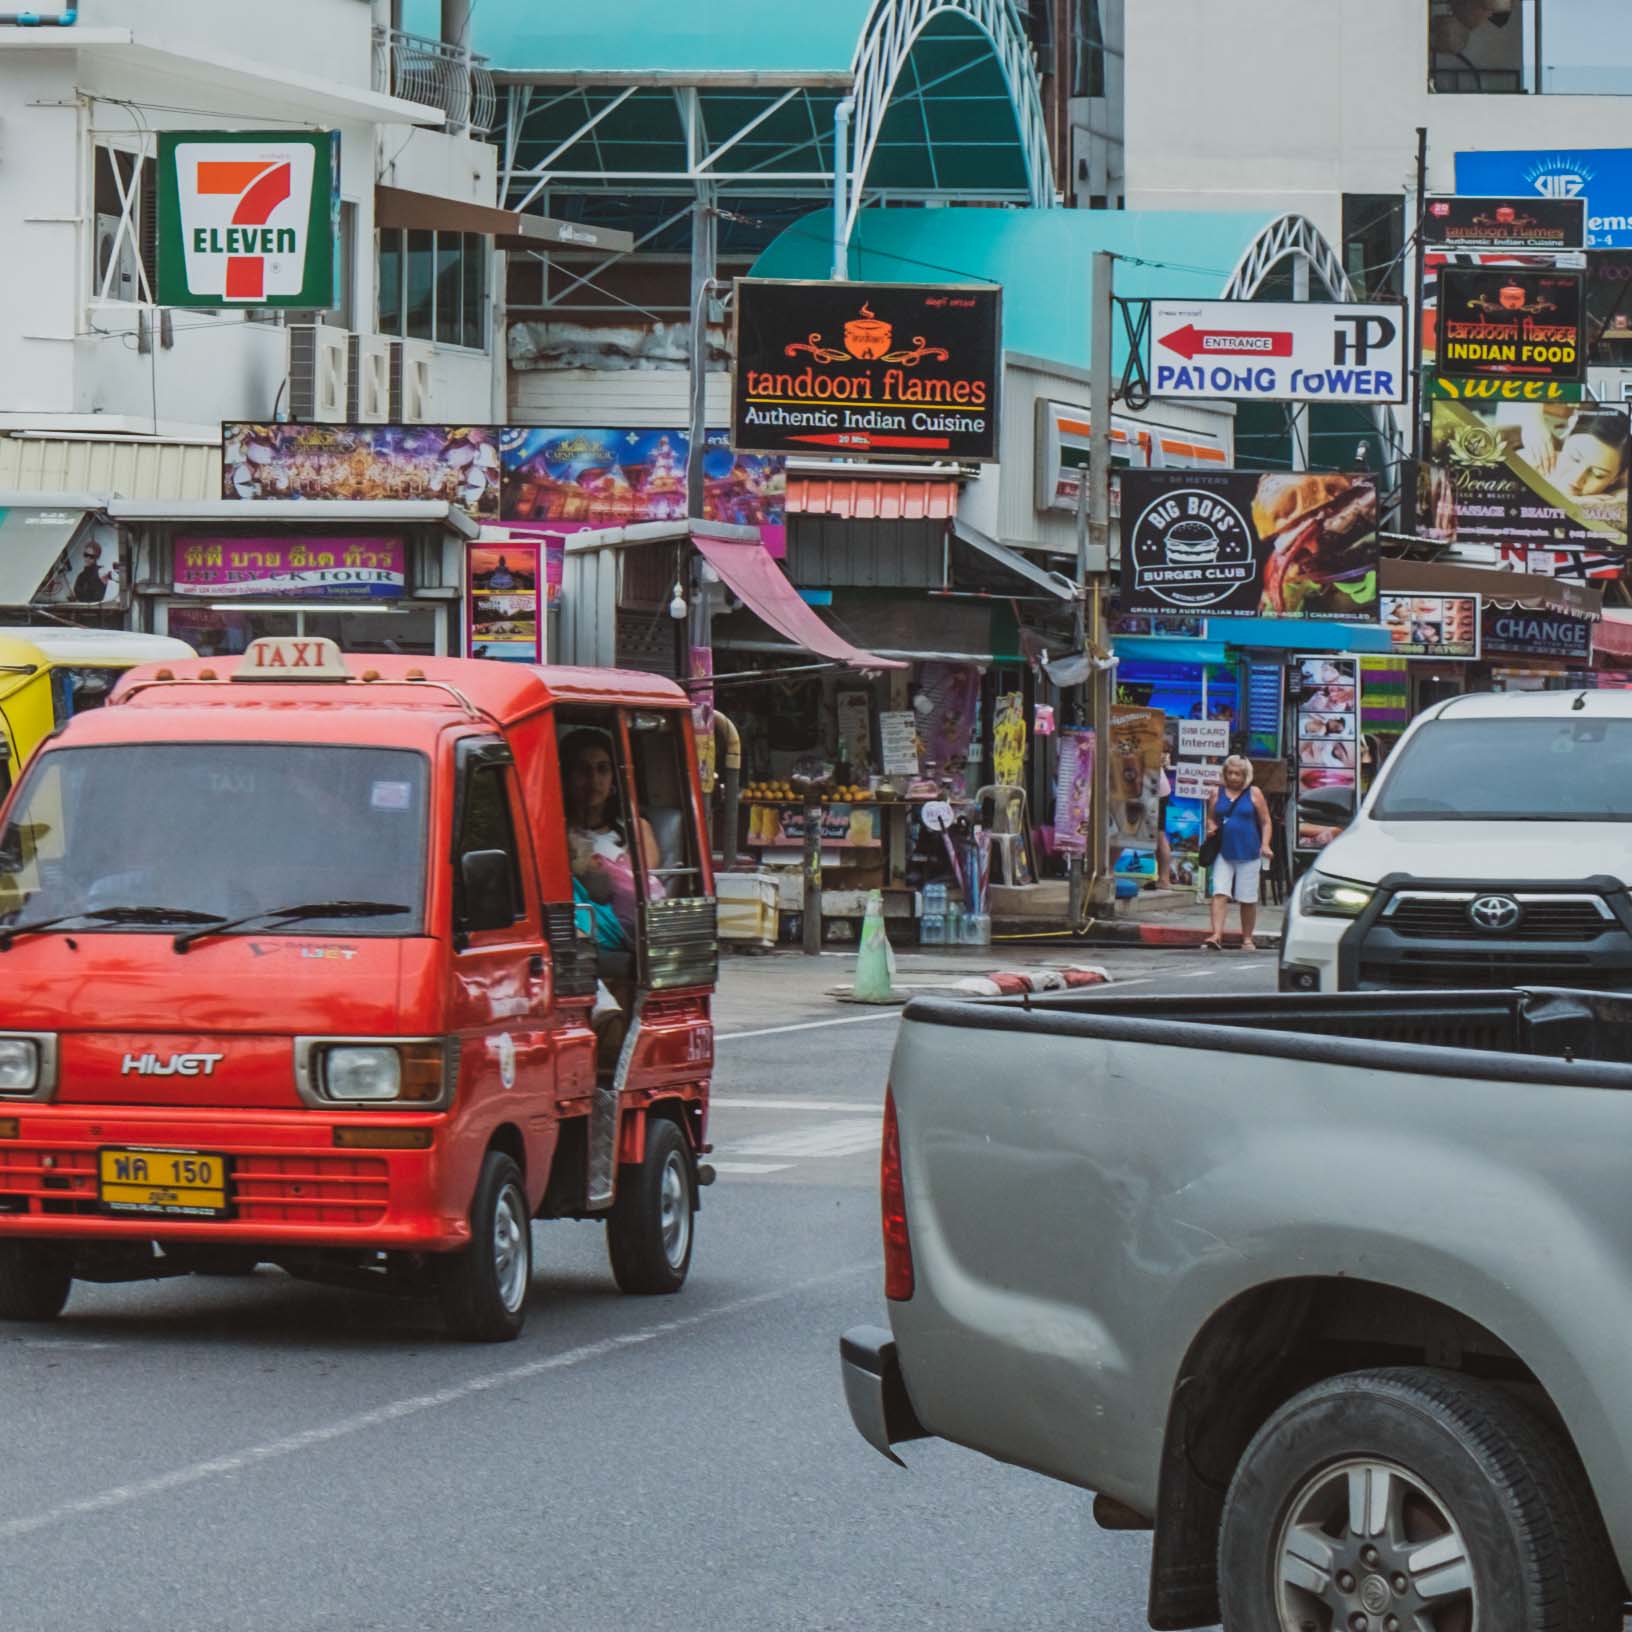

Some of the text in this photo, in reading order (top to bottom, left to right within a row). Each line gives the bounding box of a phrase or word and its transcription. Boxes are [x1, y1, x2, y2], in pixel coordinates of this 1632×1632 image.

[1204, 337, 1272, 350] ENTRANCE
[1447, 343, 1576, 363] INDIAN FOOD
[746, 367, 987, 404] tandoori flames
[744, 406, 986, 434] Authentic Indian Cuisine
[1148, 500, 1181, 530] BIG
[230, 551, 281, 567] บาย
[184, 569, 218, 581] PP
[316, 570, 393, 582] TOUR
[1143, 567, 1246, 582] BURGER CLUB
[253, 642, 326, 669] TAXI
[1200, 727, 1226, 737] CARD
[1181, 737, 1226, 749] Internet
[121, 1053, 225, 1076] HIJET
[170, 1159, 212, 1184] 150
